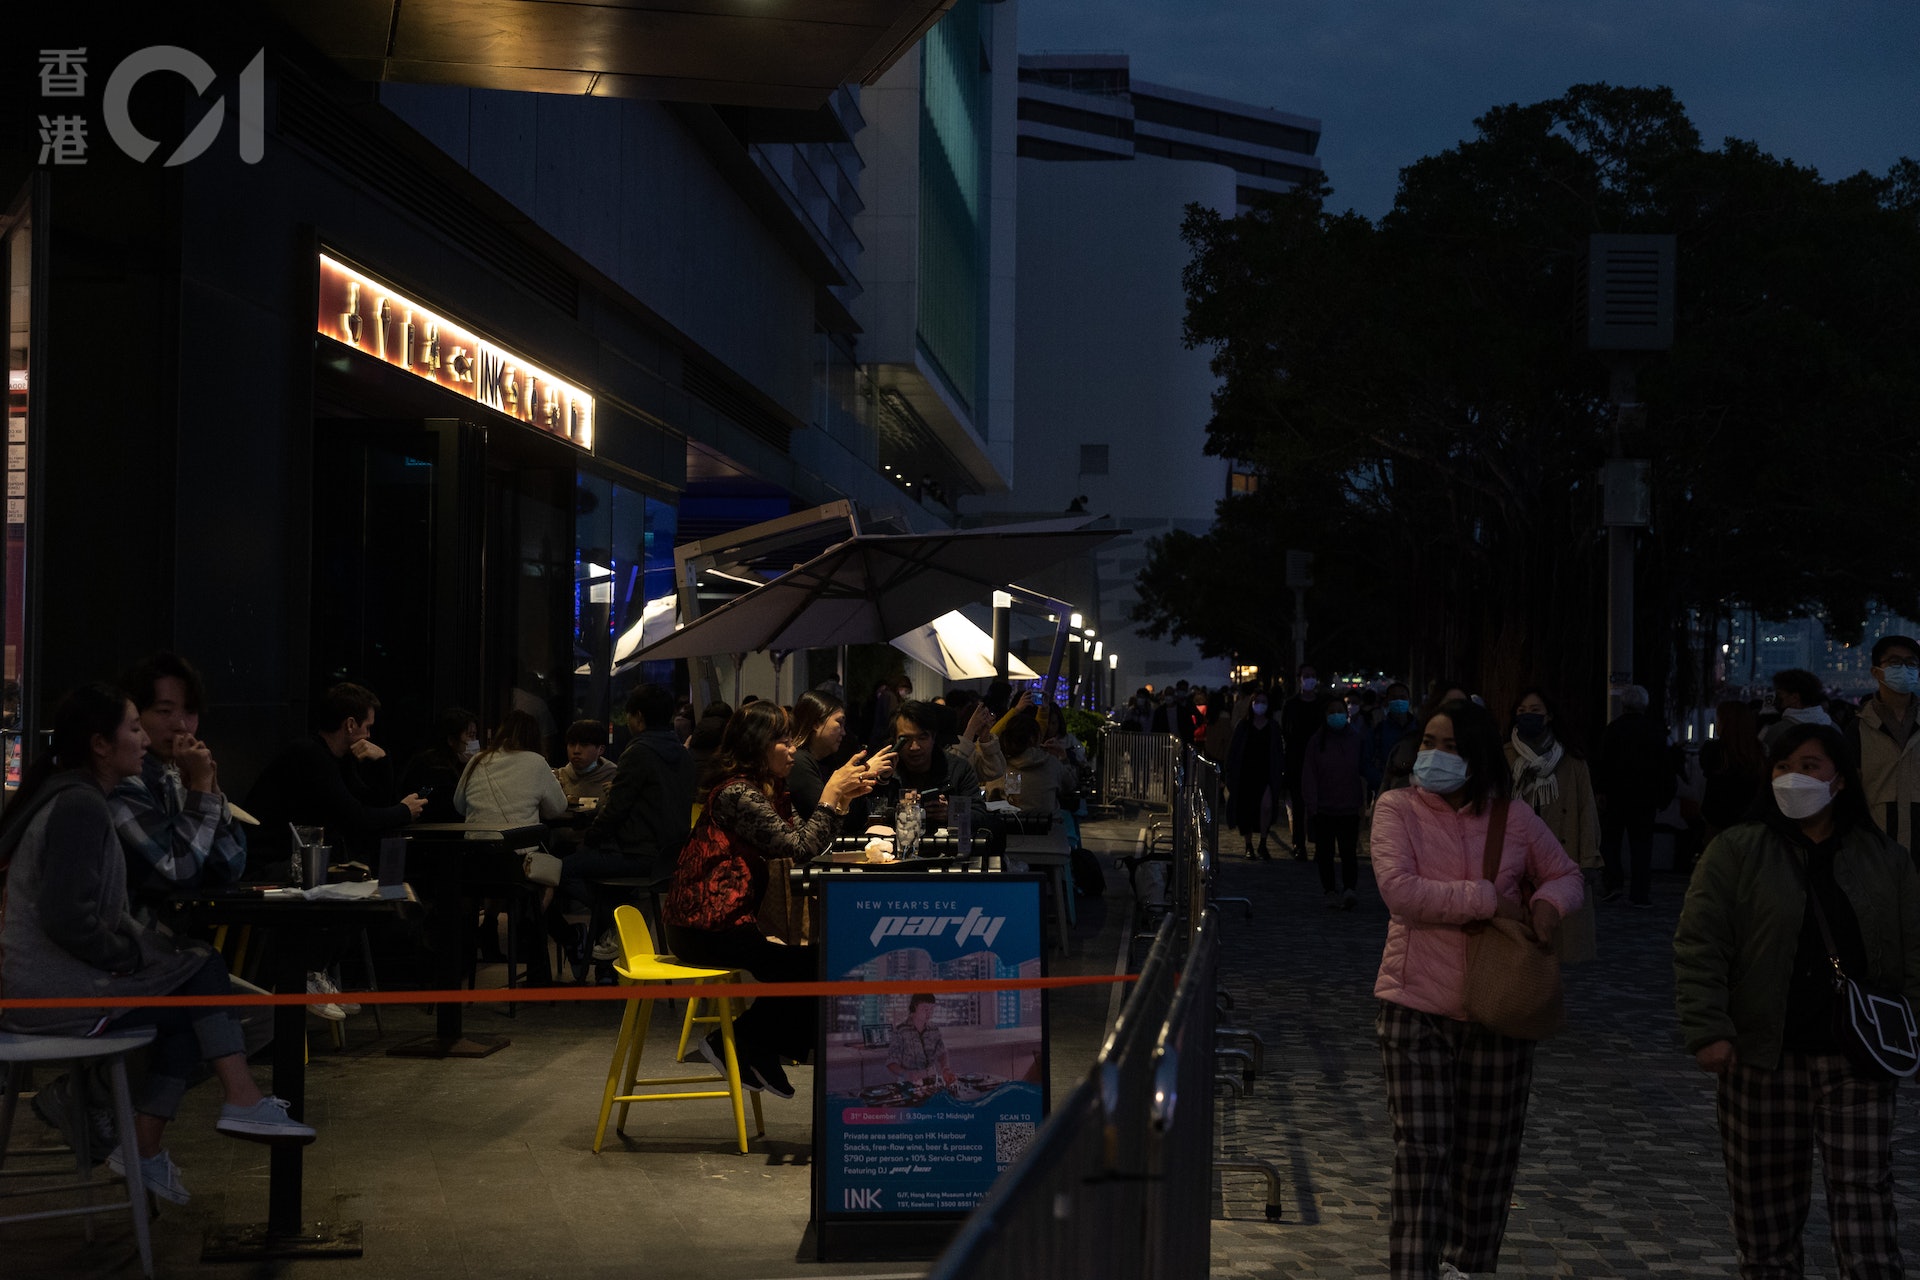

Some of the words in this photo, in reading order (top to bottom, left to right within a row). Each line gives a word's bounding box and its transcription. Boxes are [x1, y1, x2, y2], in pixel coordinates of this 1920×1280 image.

[480, 348, 506, 412] INK
[856, 901, 882, 909] NEW
[887, 901, 929, 909] YEAR'S
[935, 901, 957, 909] EVE
[869, 907, 1007, 948] party
[946, 1112, 975, 1121] Midnight
[844, 1132, 869, 1140] Private
[888, 1132, 914, 1141] seating
[938, 1132, 967, 1140] Harbour
[844, 1143, 872, 1152] Snacks,
[872, 1143, 905, 1151] free-flow
[926, 1143, 942, 1151] beer
[843, 1154, 864, 1162] $790
[928, 1154, 955, 1162] Service
[956, 1154, 983, 1163] Charge
[844, 1167, 877, 1175] Featuring
[844, 1187, 882, 1209] INK
